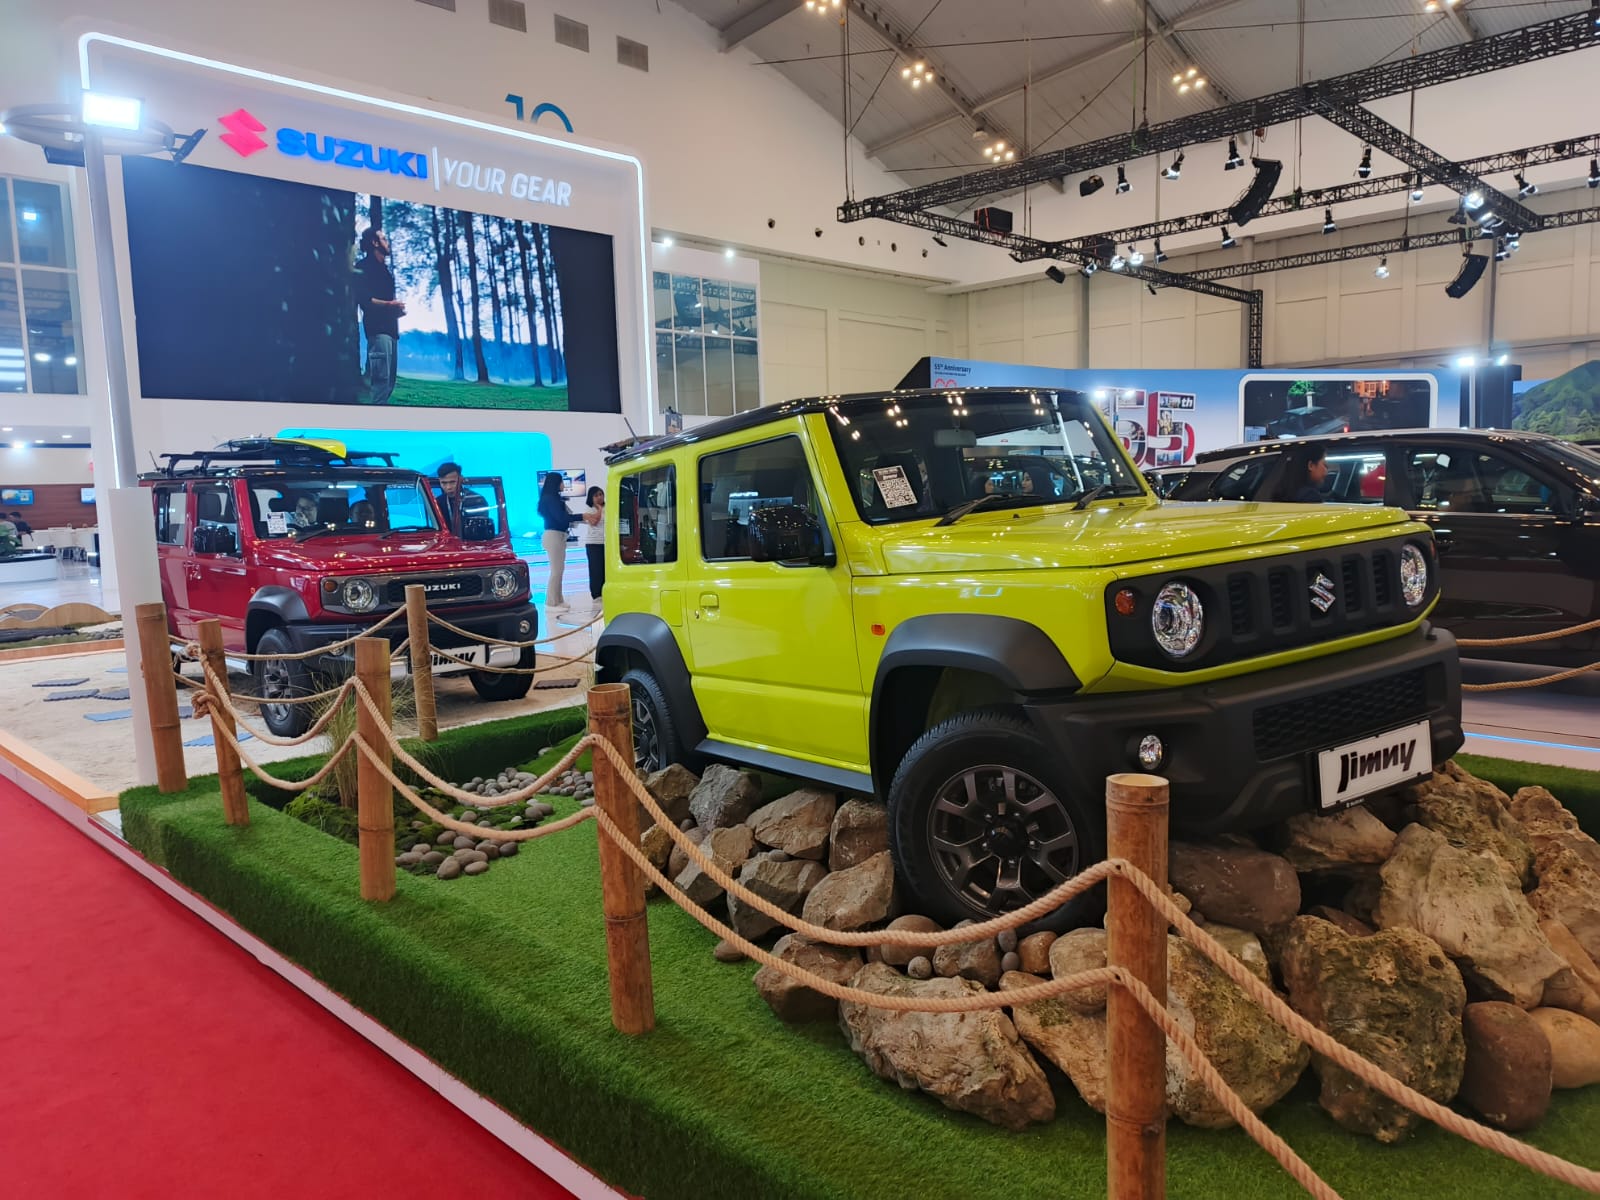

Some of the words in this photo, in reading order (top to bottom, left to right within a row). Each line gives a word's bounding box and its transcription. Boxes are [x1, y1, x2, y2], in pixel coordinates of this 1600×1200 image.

[276, 127, 428, 179] SUZUKI
[443, 157, 506, 195] YOUR
[510, 172, 572, 207] GEAR
[944, 364, 972, 374] Anniversary
[424, 583, 461, 592] UZUKI
[1337, 739, 1417, 794] Jimny
